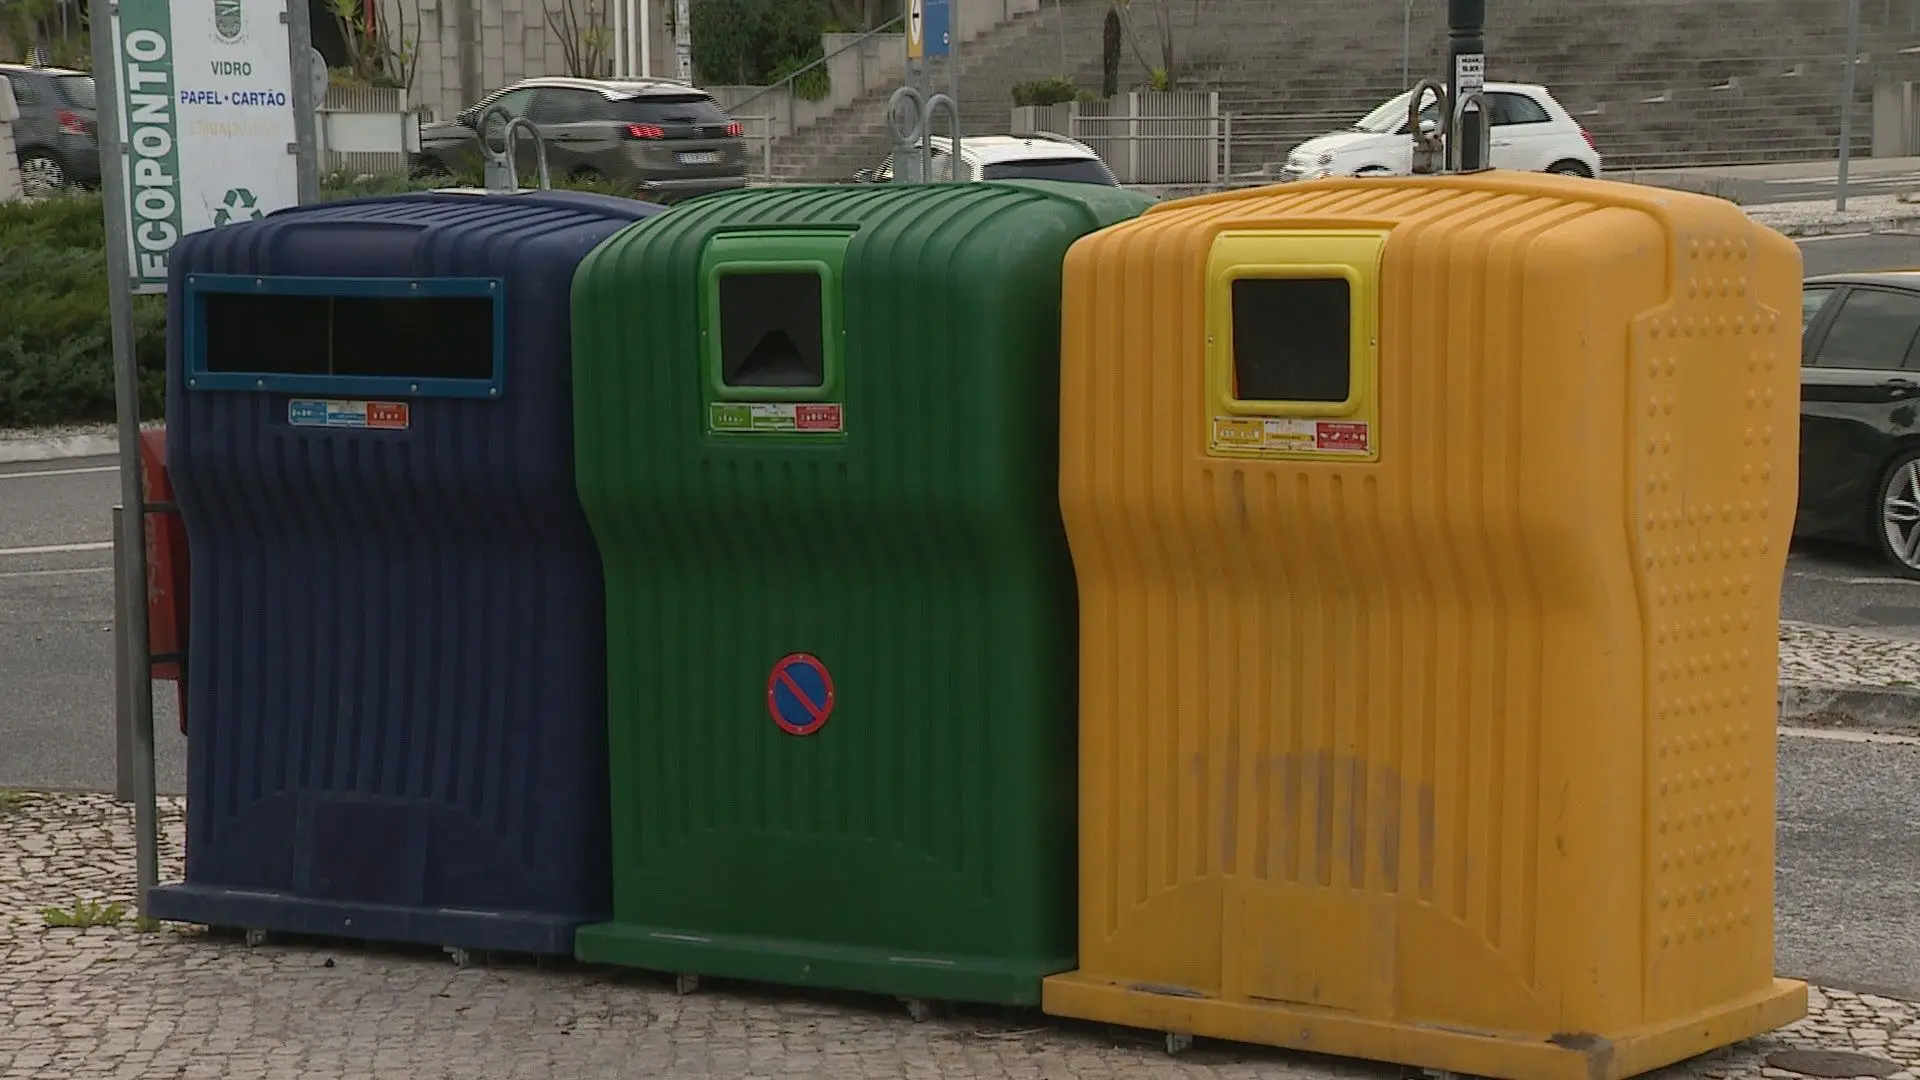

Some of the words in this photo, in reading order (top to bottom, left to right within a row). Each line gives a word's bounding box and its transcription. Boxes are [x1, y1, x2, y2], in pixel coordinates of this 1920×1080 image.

[211, 61, 251, 76] VIDRO
[181, 90, 222, 105] PAPEL
[231, 88, 286, 106] CARTÃO
[125, 29, 178, 277] ECOPONTO
